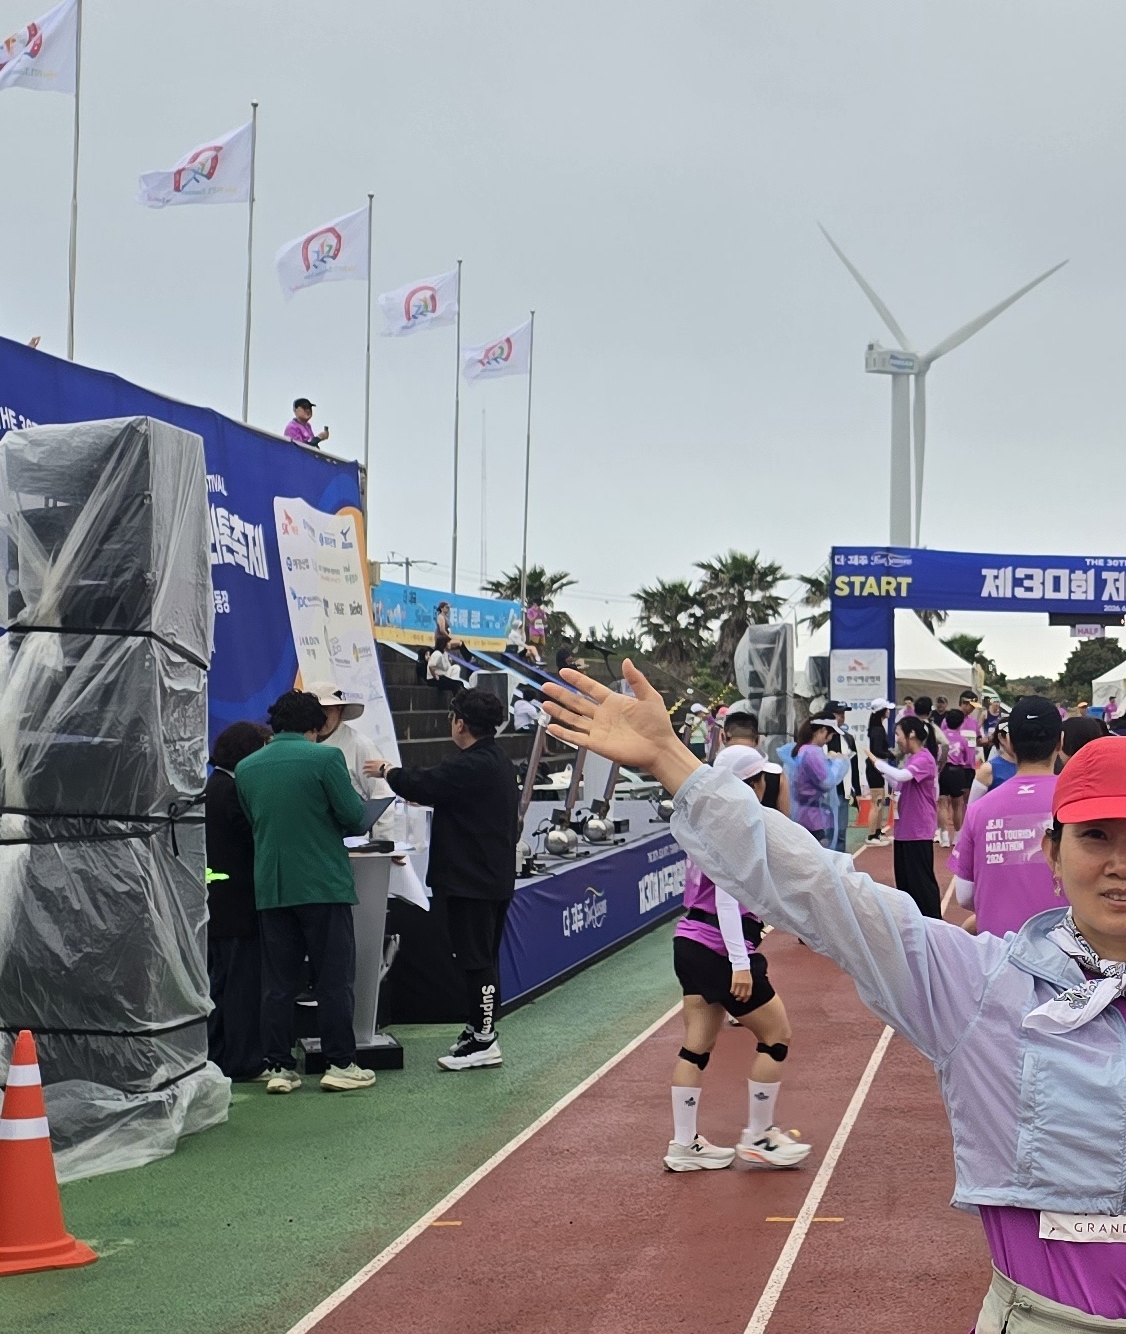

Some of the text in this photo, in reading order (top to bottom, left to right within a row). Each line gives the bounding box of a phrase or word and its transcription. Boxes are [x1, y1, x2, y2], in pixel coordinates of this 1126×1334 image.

[0, 406, 19, 430] HE
[1085, 558, 1104, 567] THE
[834, 575, 912, 597] START
[981, 566, 1095, 601] 제30회
[986, 818, 1004, 830] JEJU
[986, 828, 1036, 841] INT'L TOURISM
[986, 840, 1024, 853] MARATHON
[986, 853, 1005, 865] 2026
